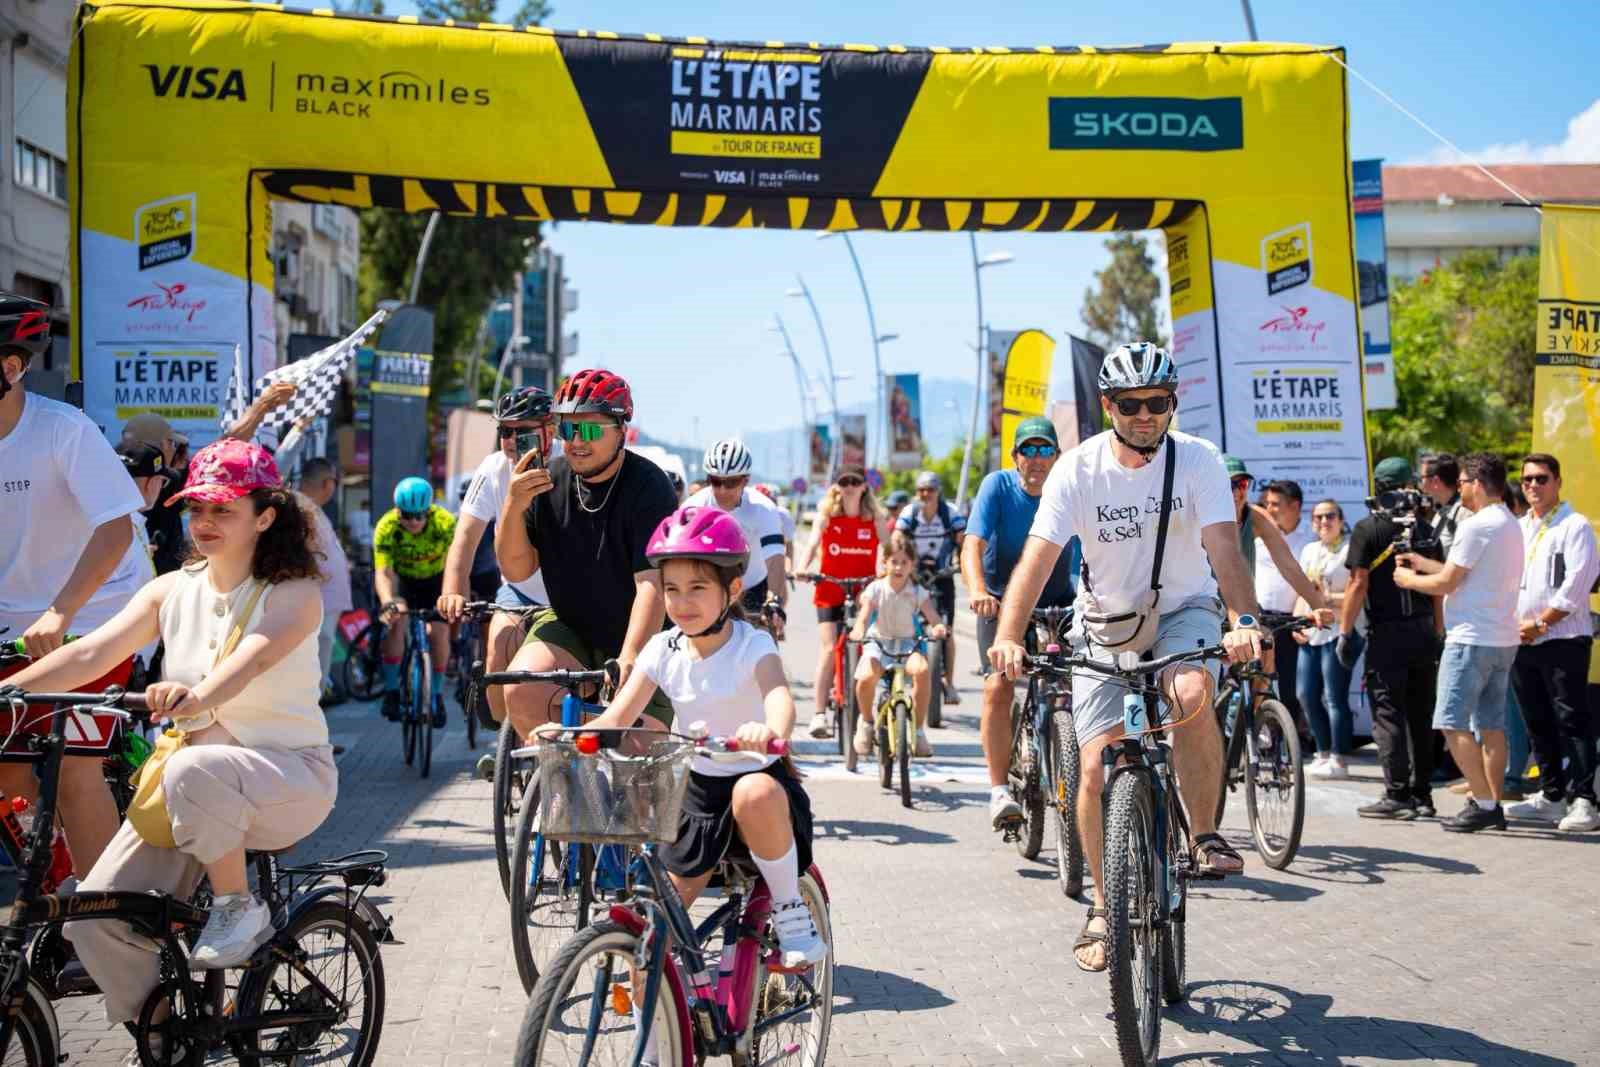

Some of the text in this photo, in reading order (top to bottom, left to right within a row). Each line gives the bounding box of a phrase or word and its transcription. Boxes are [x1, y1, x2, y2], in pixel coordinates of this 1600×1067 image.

[142, 64, 491, 106] VISA maximiles
[672, 50, 821, 101] L'ÉTAPE
[296, 99, 371, 118] BLACK
[722, 139, 752, 152] TOUR
[754, 141, 769, 153] DE
[771, 141, 815, 154] FRANCE
[714, 170, 746, 184] VISA
[758, 170, 820, 182] maximiles
[115, 352, 217, 383] L'ÉTAPE
[1253, 370, 1339, 399] L'ÉTAPE
[1096, 496, 1184, 522] Keep Cam
[1098, 528, 1114, 543] &
